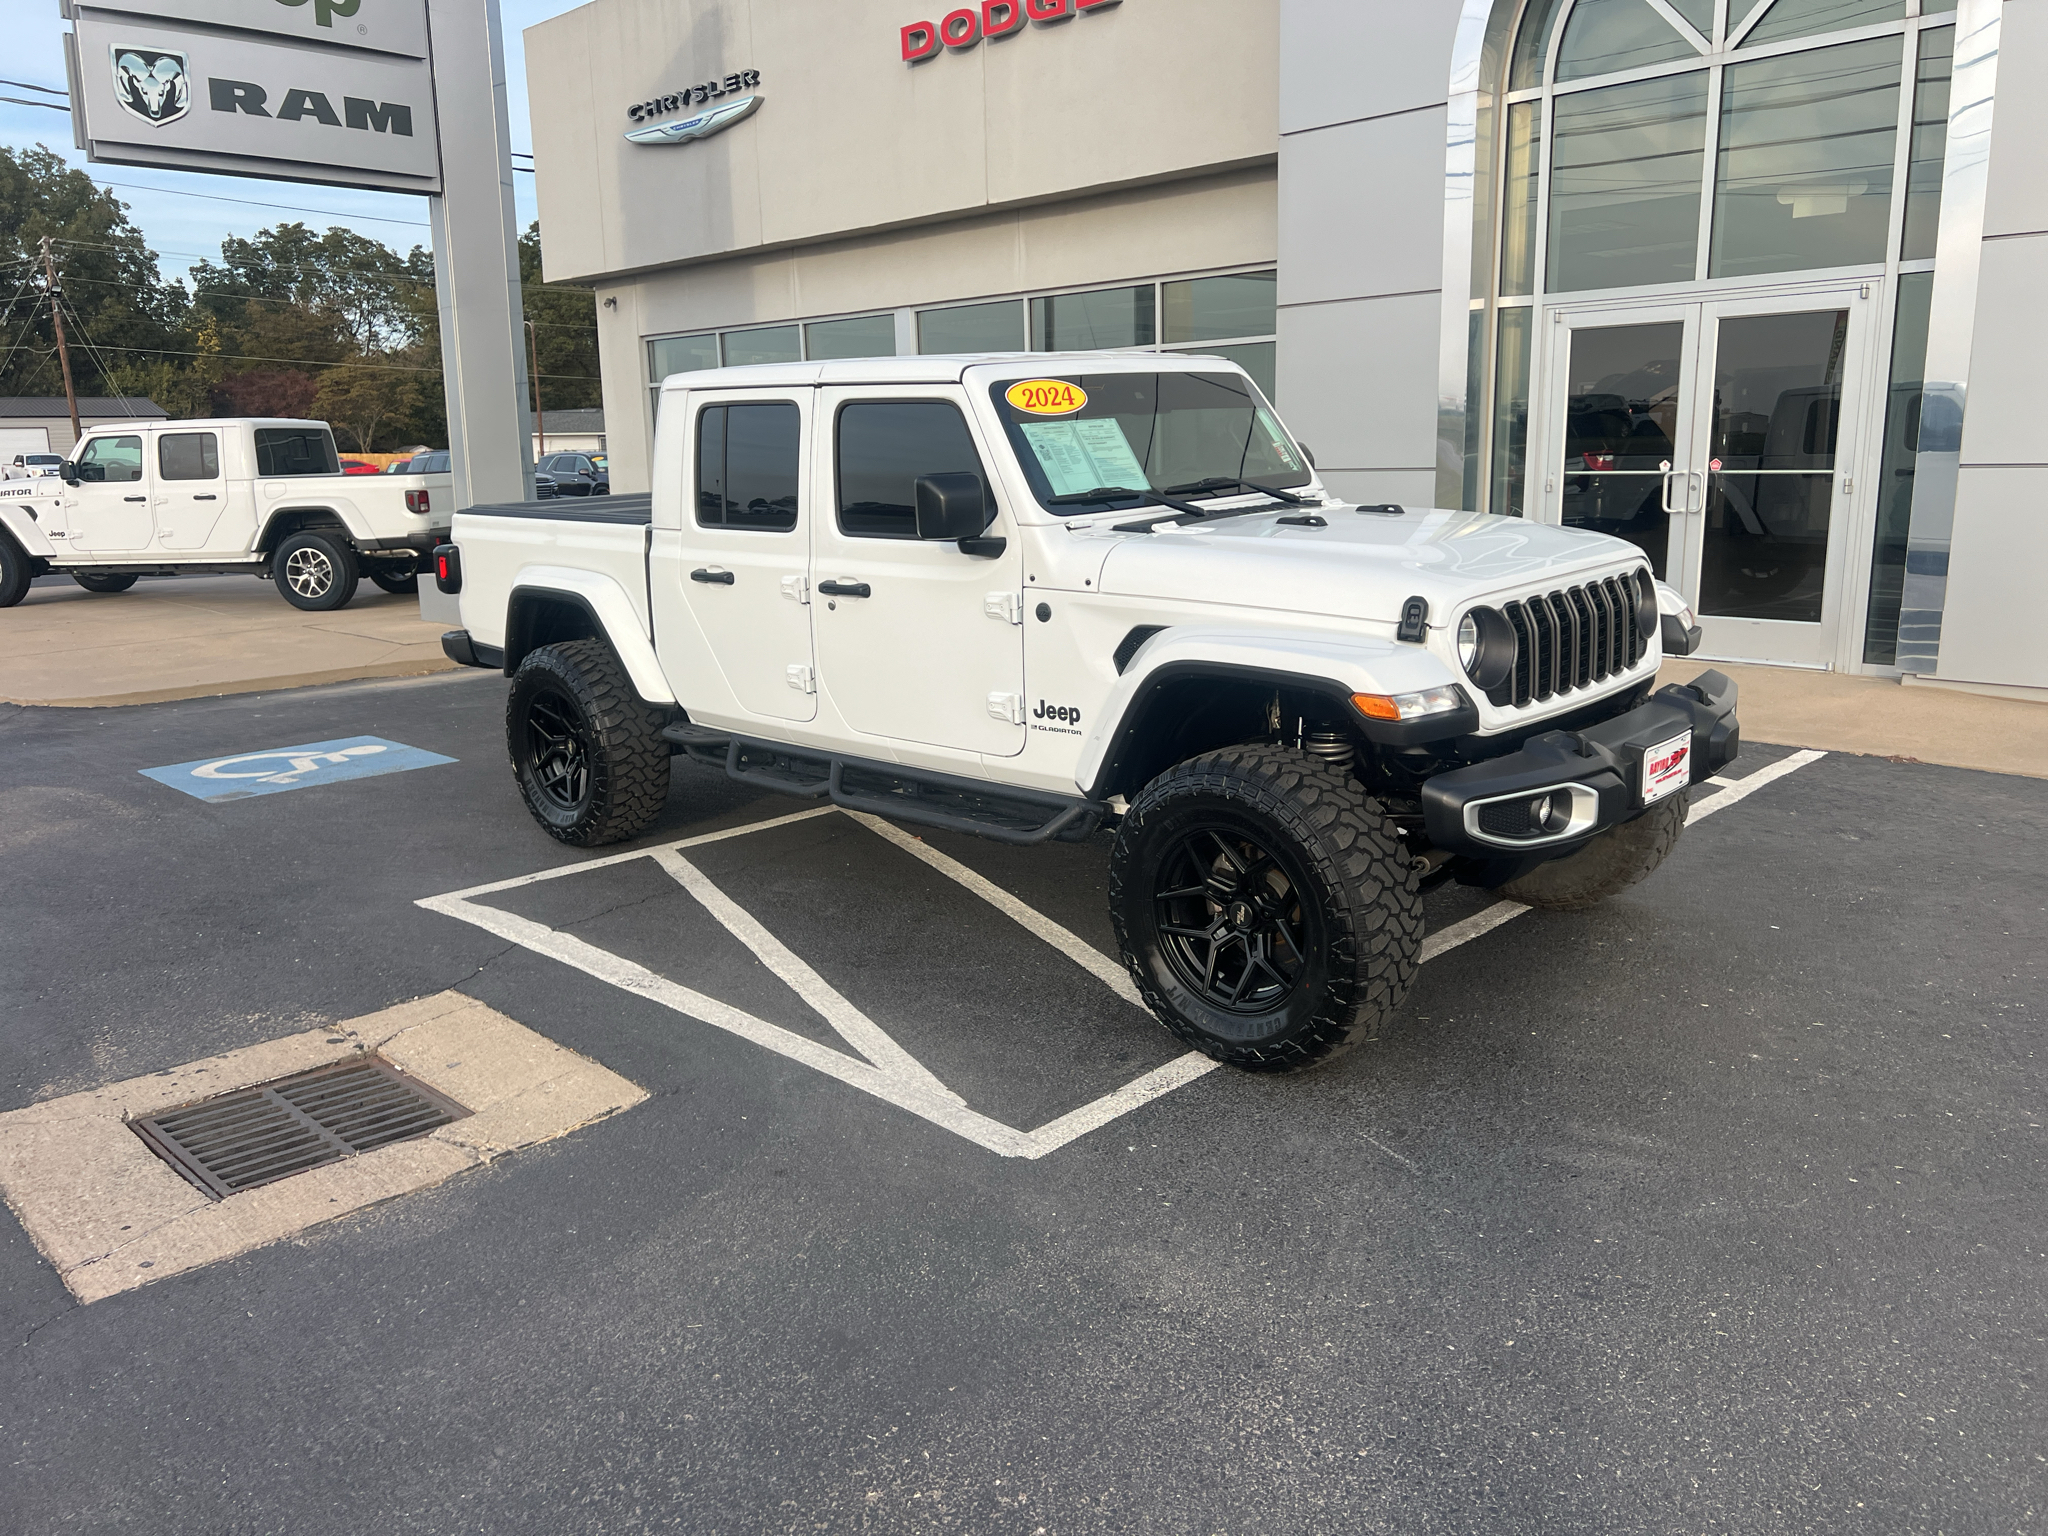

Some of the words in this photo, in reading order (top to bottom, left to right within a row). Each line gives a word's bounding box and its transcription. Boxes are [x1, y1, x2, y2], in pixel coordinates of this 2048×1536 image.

[900, 0, 1122, 61] DODG
[207, 77, 413, 137] RAM
[627, 69, 760, 122] CHRYSLER
[1021, 385, 1075, 408] 2024
[1033, 699, 1081, 726] Jeep
[1038, 725, 1082, 735] GLADIATOR
[1165, 985, 1193, 1012] M/T
